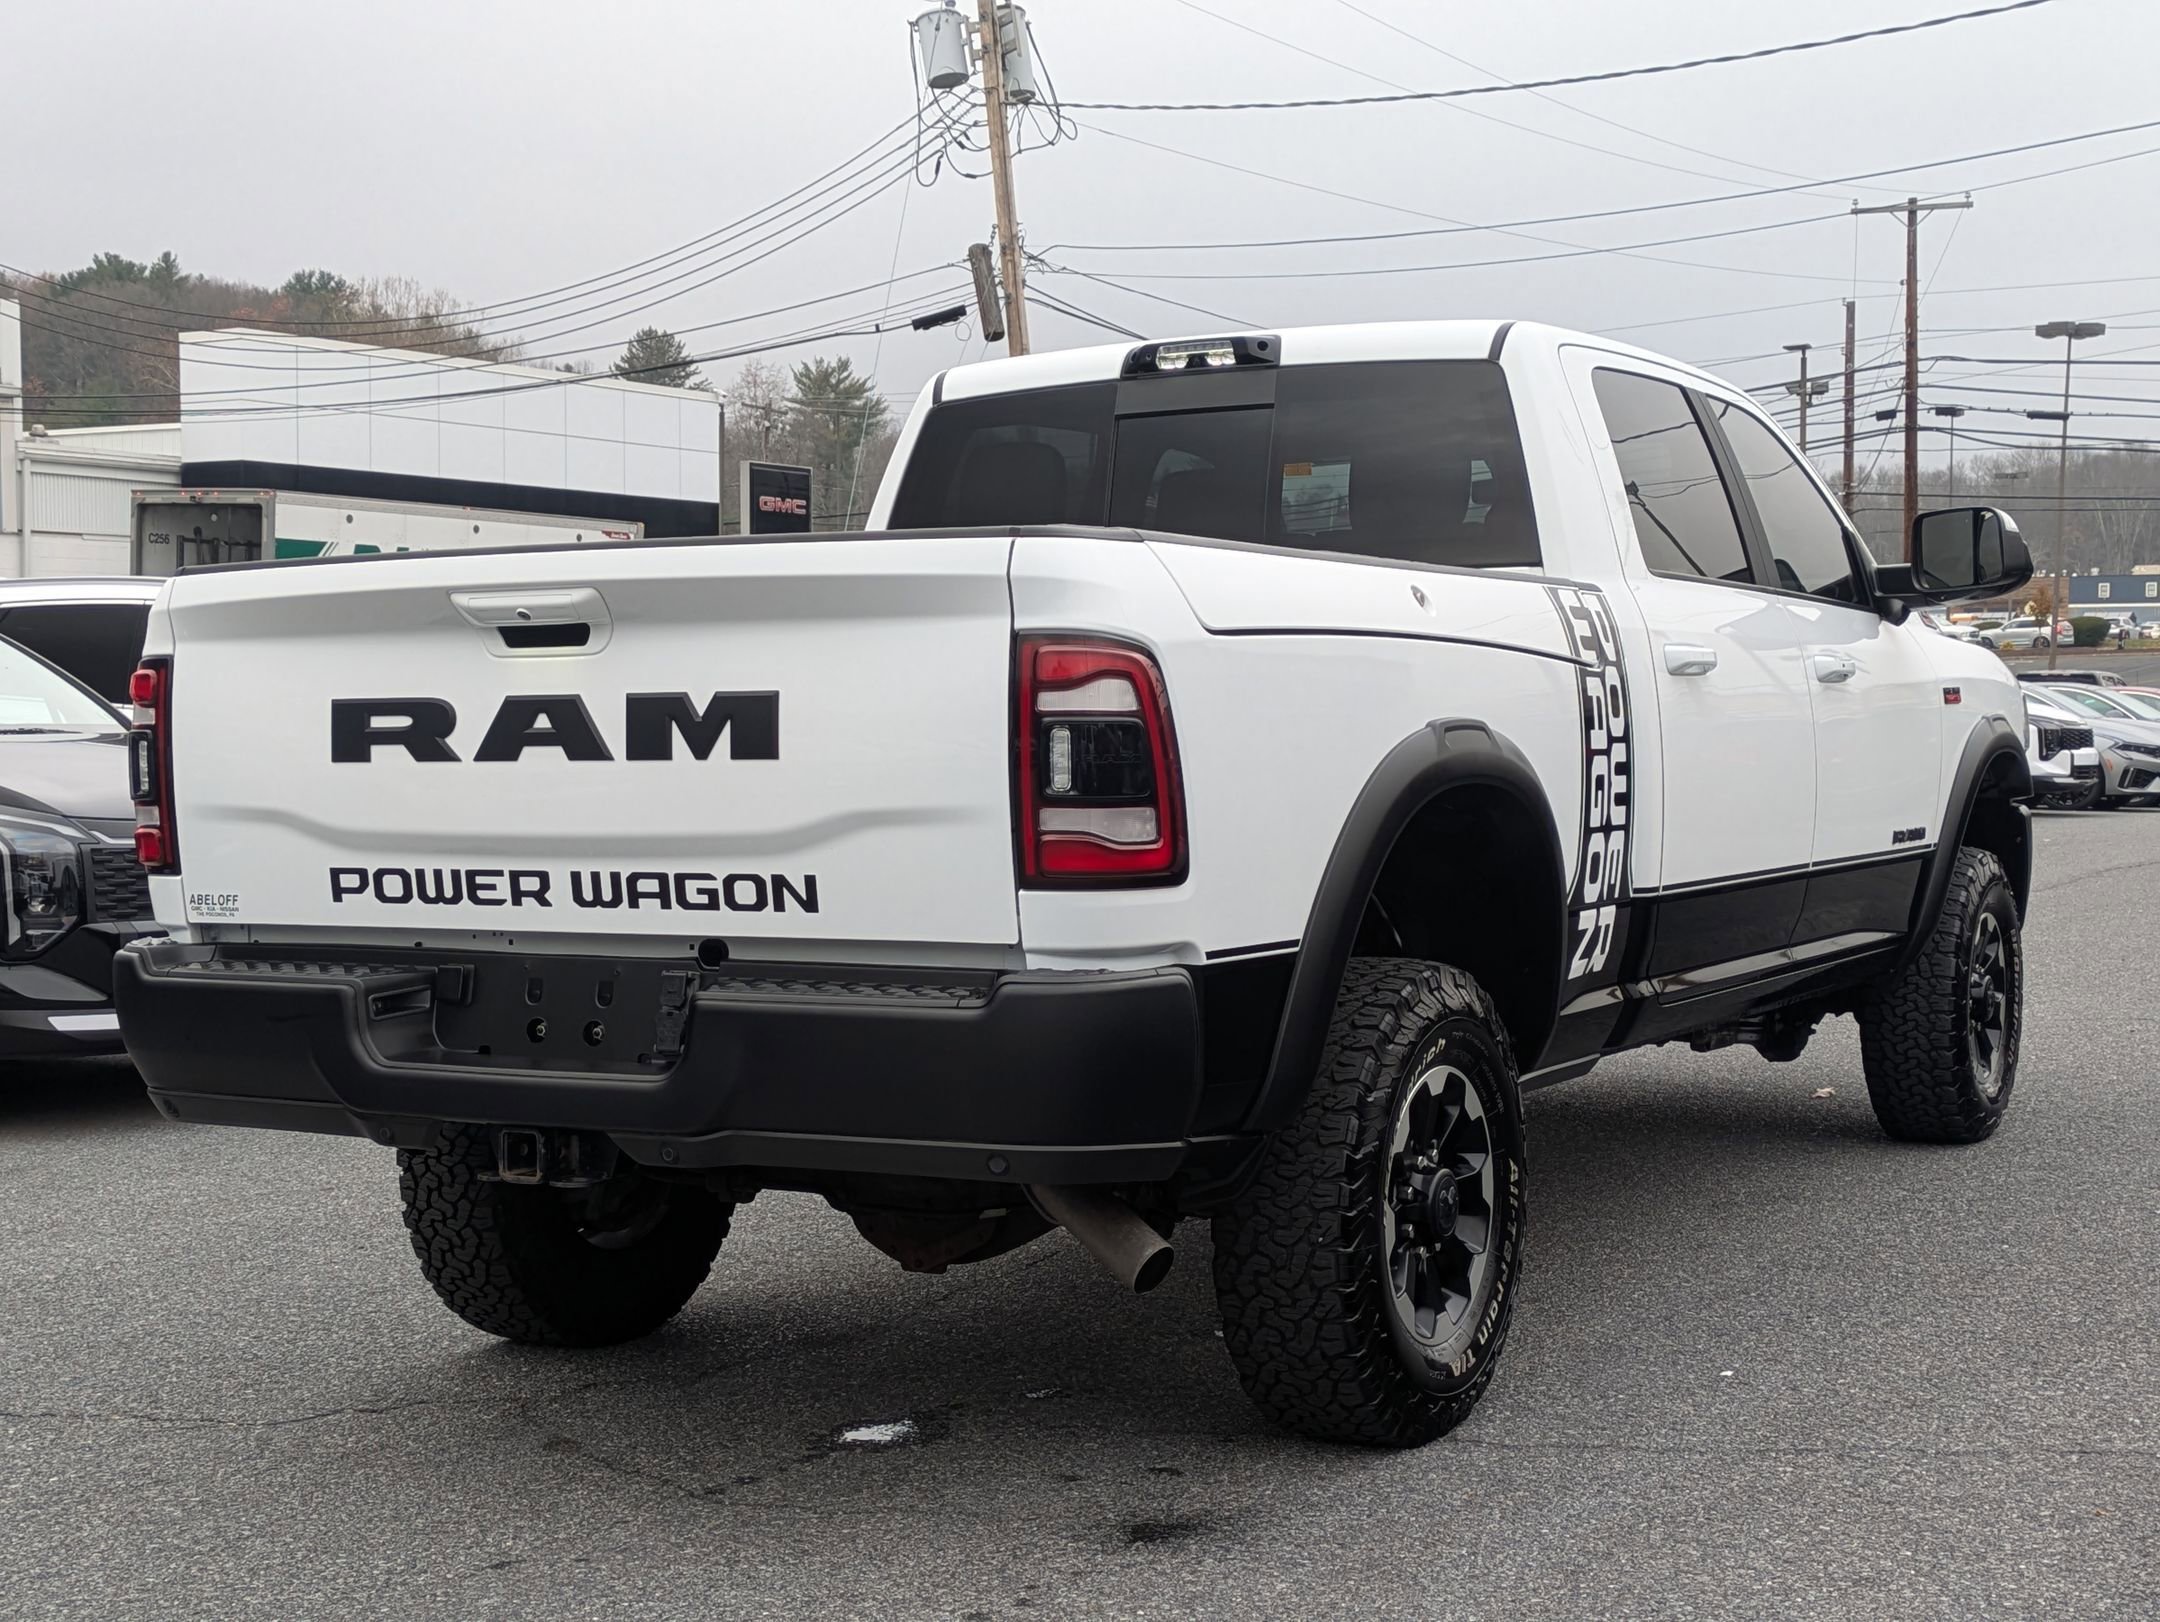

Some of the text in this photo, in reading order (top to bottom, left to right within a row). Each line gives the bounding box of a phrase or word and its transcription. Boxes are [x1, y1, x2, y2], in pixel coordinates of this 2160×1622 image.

[759, 495, 807, 515] GMC
[148, 532, 170, 544] C256
[331, 690, 780, 763] RAM
[1558, 588, 1609, 981] WAGON
[1581, 591, 1627, 973] POWER
[190, 894, 239, 906] ABELOFF
[329, 867, 820, 914] POWER WAGON
